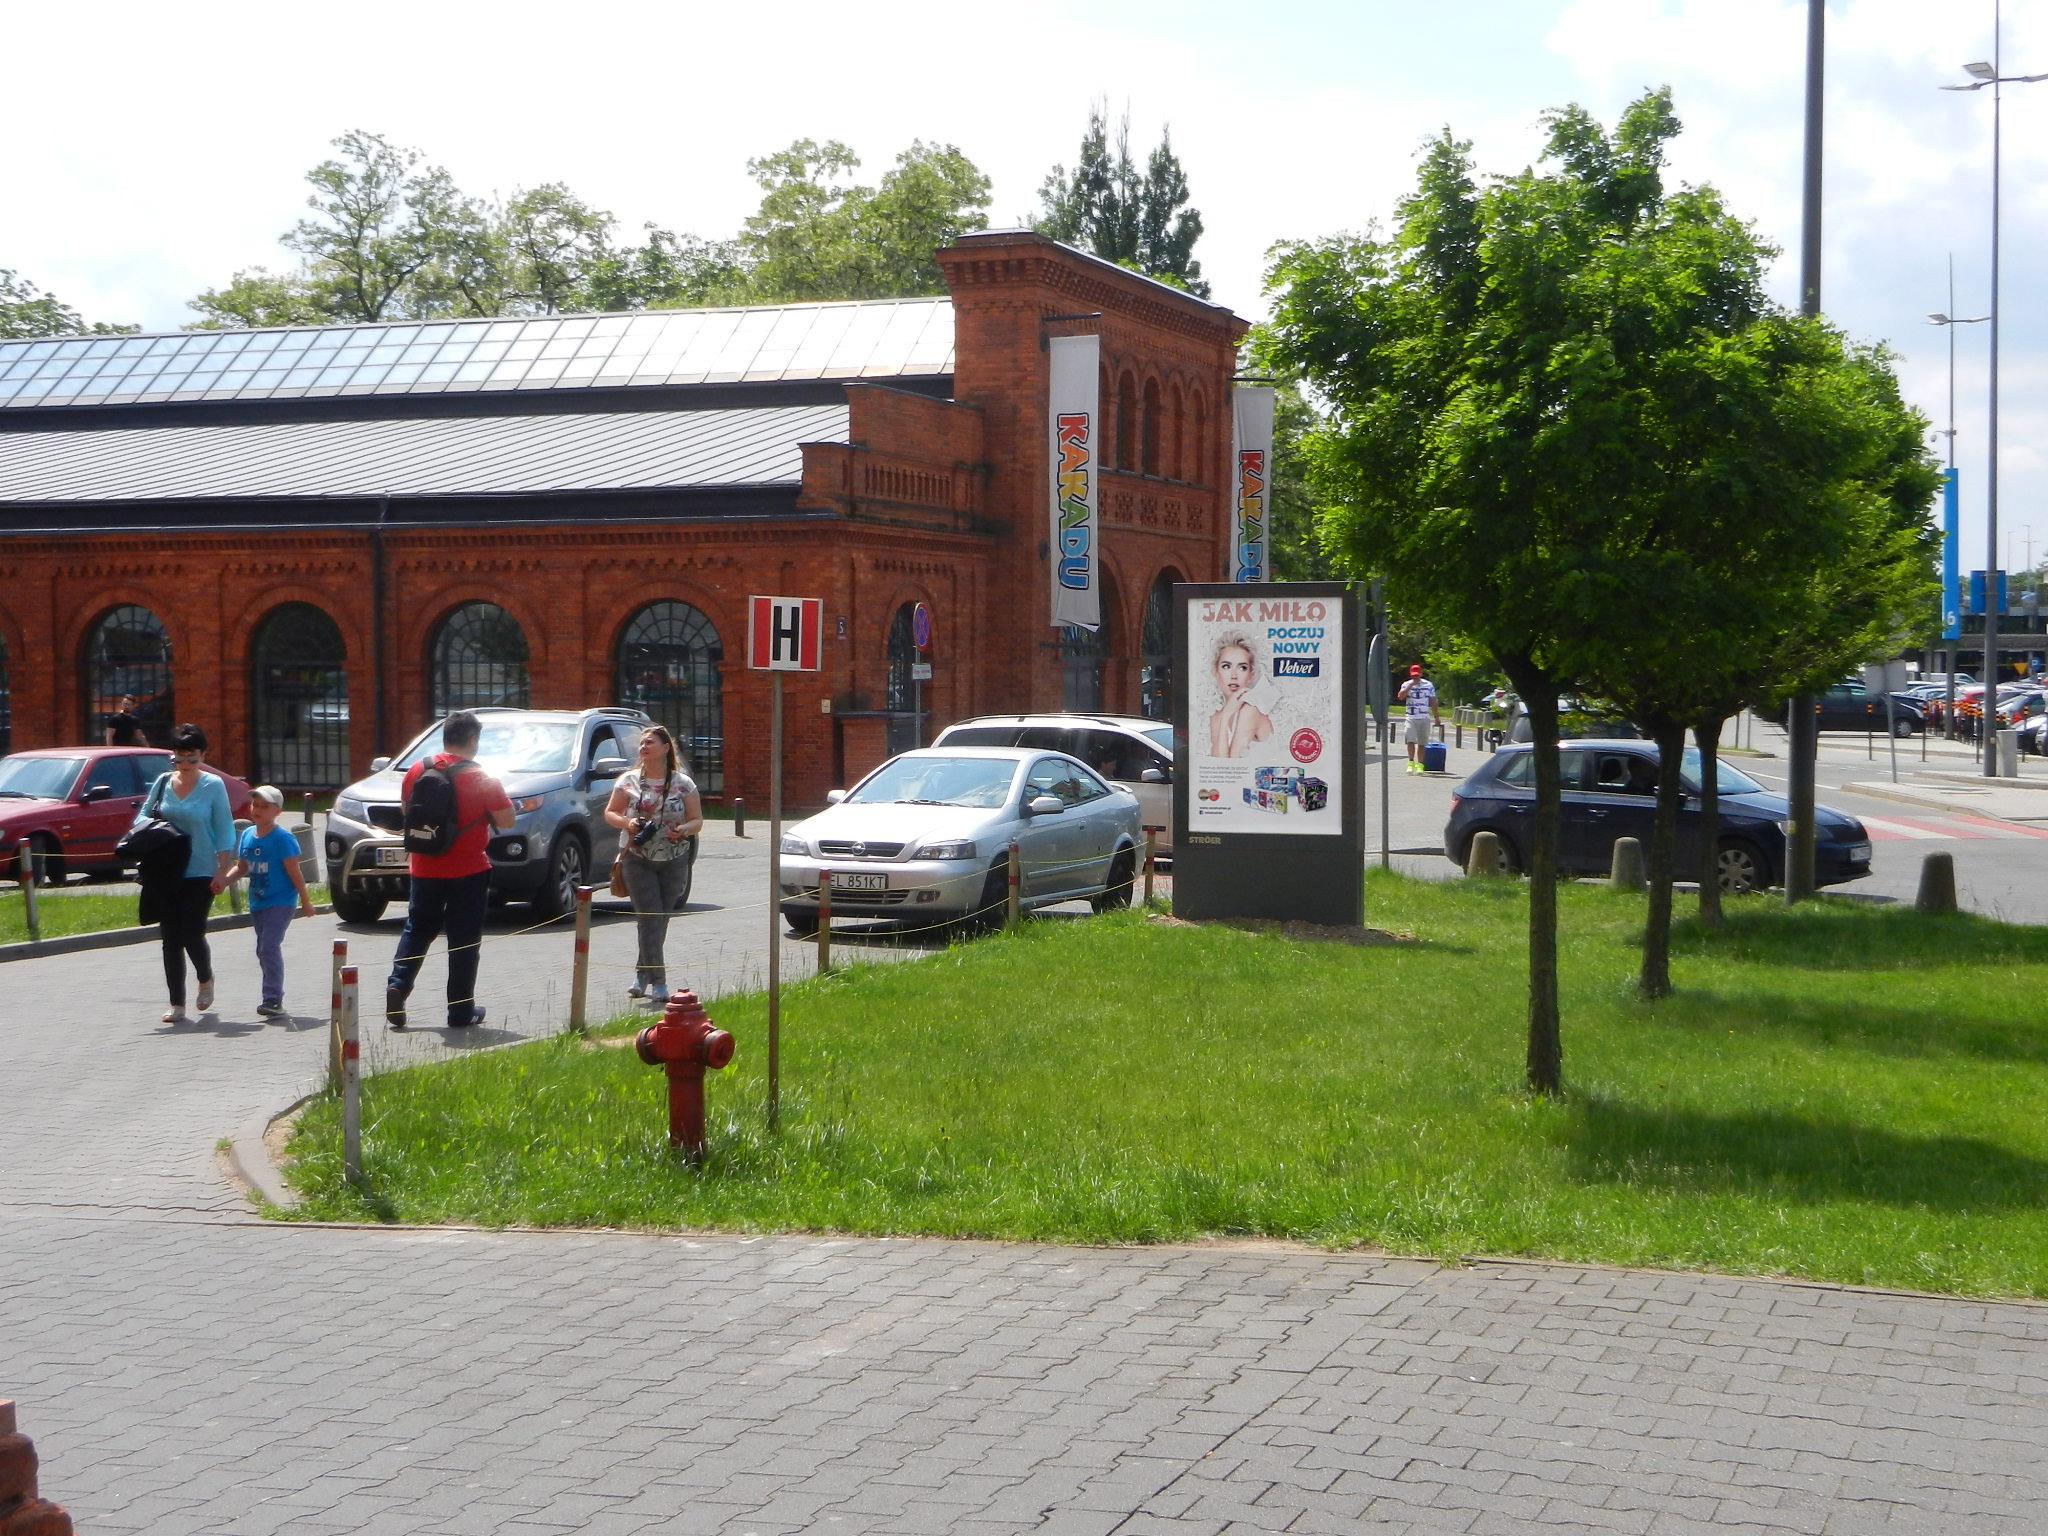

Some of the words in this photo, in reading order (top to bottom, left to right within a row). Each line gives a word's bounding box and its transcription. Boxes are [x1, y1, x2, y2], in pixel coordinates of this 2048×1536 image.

[1057, 412, 1090, 590] KAKADU
[1202, 602, 1253, 622] JAK
[1258, 601, 1327, 622] MIŁO
[1946, 611, 1956, 626] 6
[772, 605, 800, 661] H
[1267, 627, 1324, 639] POCZUJ
[1273, 643, 1320, 653] NOWY
[1279, 660, 1314, 674] Velvet
[848, 875, 883, 888] 851KT
